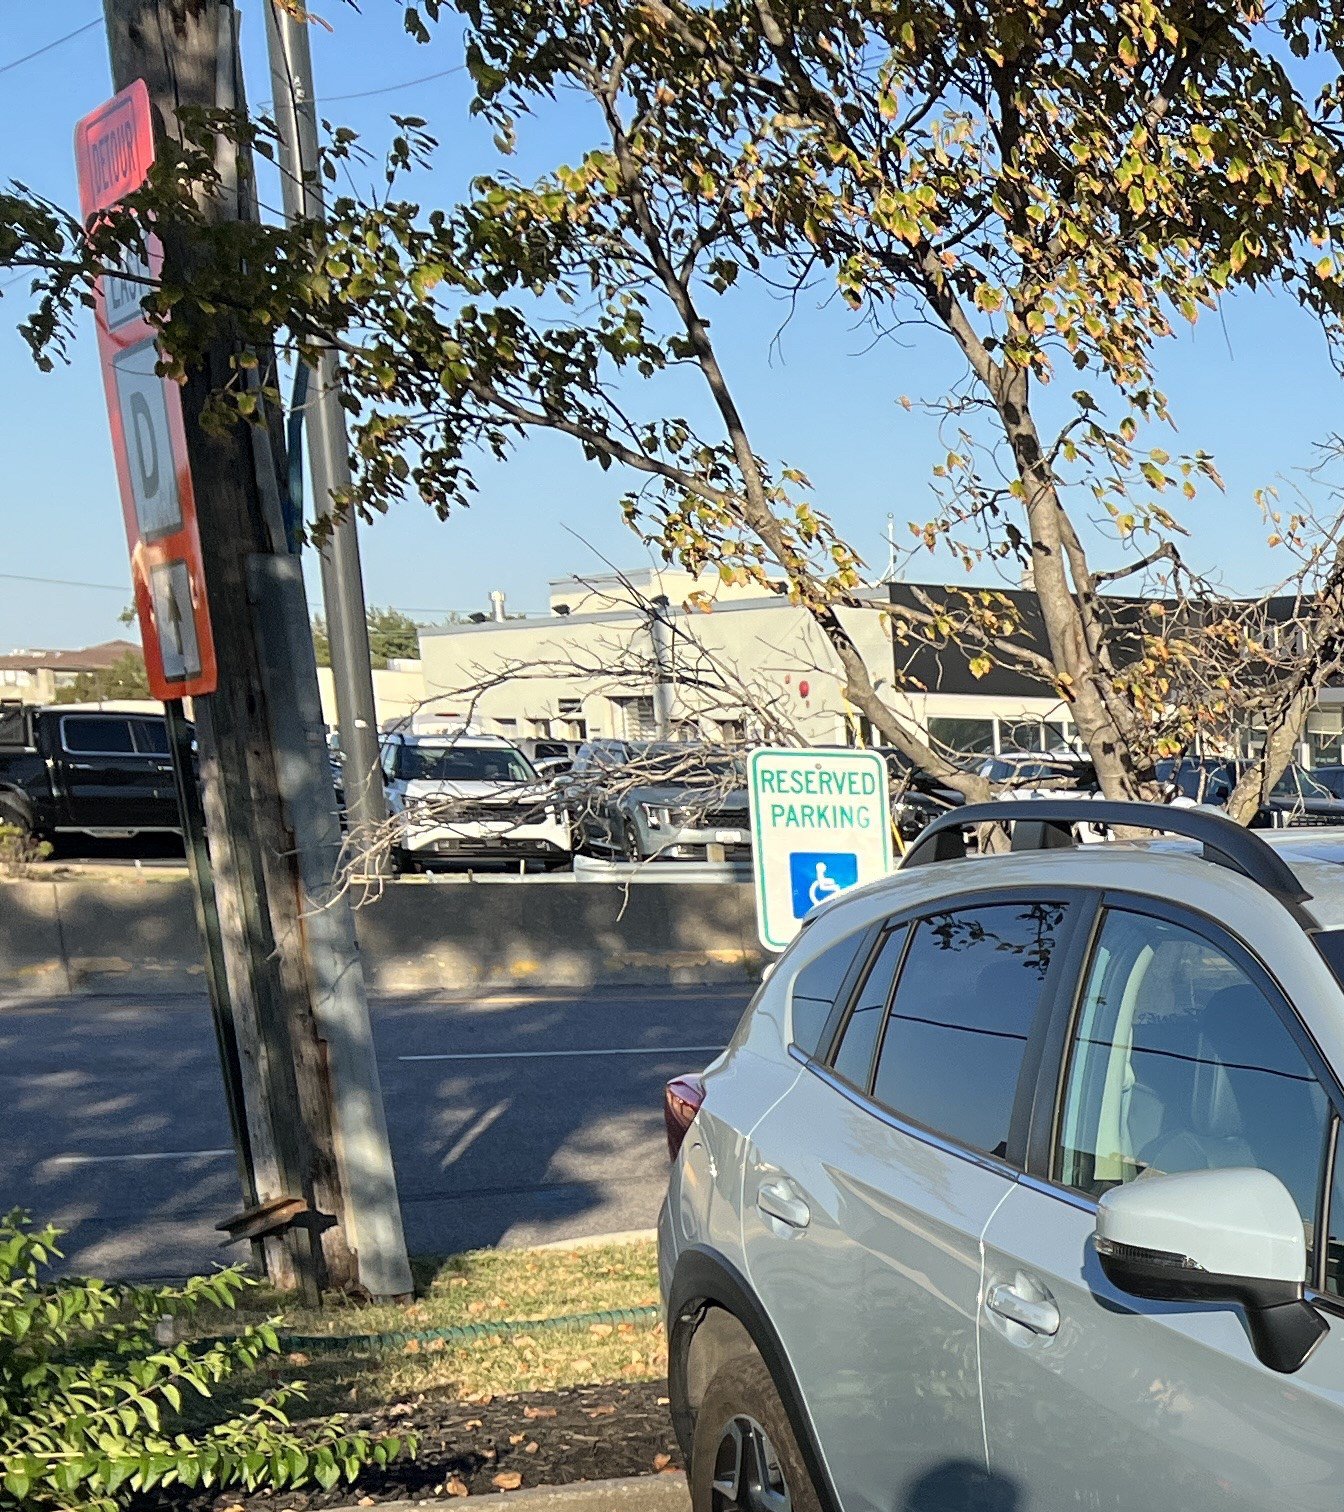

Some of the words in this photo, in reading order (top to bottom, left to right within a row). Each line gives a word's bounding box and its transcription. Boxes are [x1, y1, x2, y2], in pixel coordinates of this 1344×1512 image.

[91, 120, 137, 192] DETOUR
[130, 391, 160, 499] D
[761, 769, 876, 795] RESERVED
[771, 804, 871, 829] PARKING
